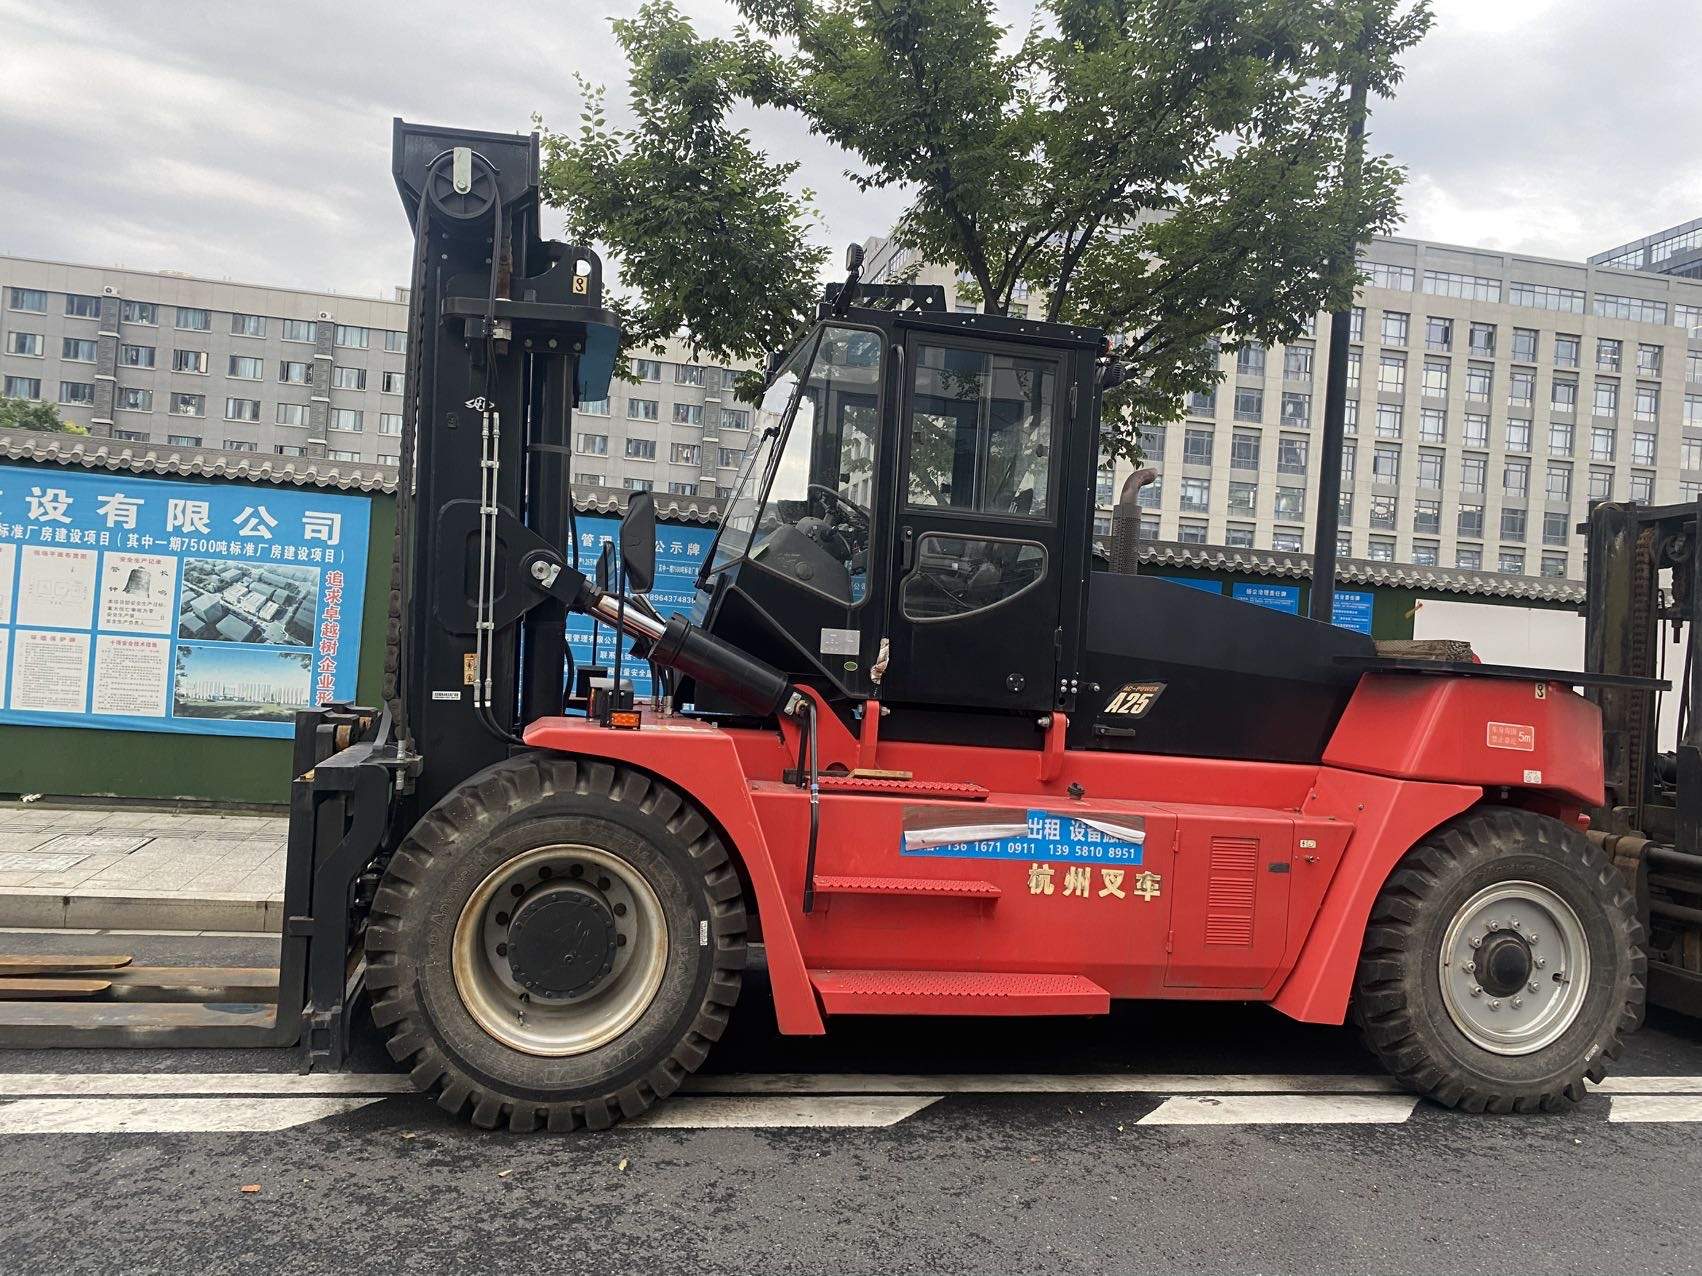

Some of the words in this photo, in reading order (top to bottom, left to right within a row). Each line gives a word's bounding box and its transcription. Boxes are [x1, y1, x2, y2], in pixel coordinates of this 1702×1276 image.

[0, 487, 341, 545] 设有限公司
[316, 570, 344, 706] 追求卓越树企业形
[1103, 692, 1154, 714] A25
[1027, 817, 1061, 841] 出租
[974, 841, 1001, 852] 1671
[1007, 842, 1036, 854] 0911
[1048, 844, 1069, 856] 139
[1074, 845, 1103, 858] 5810
[1108, 847, 1136, 859] 8951
[1028, 862, 1161, 901] 杭州叉车
